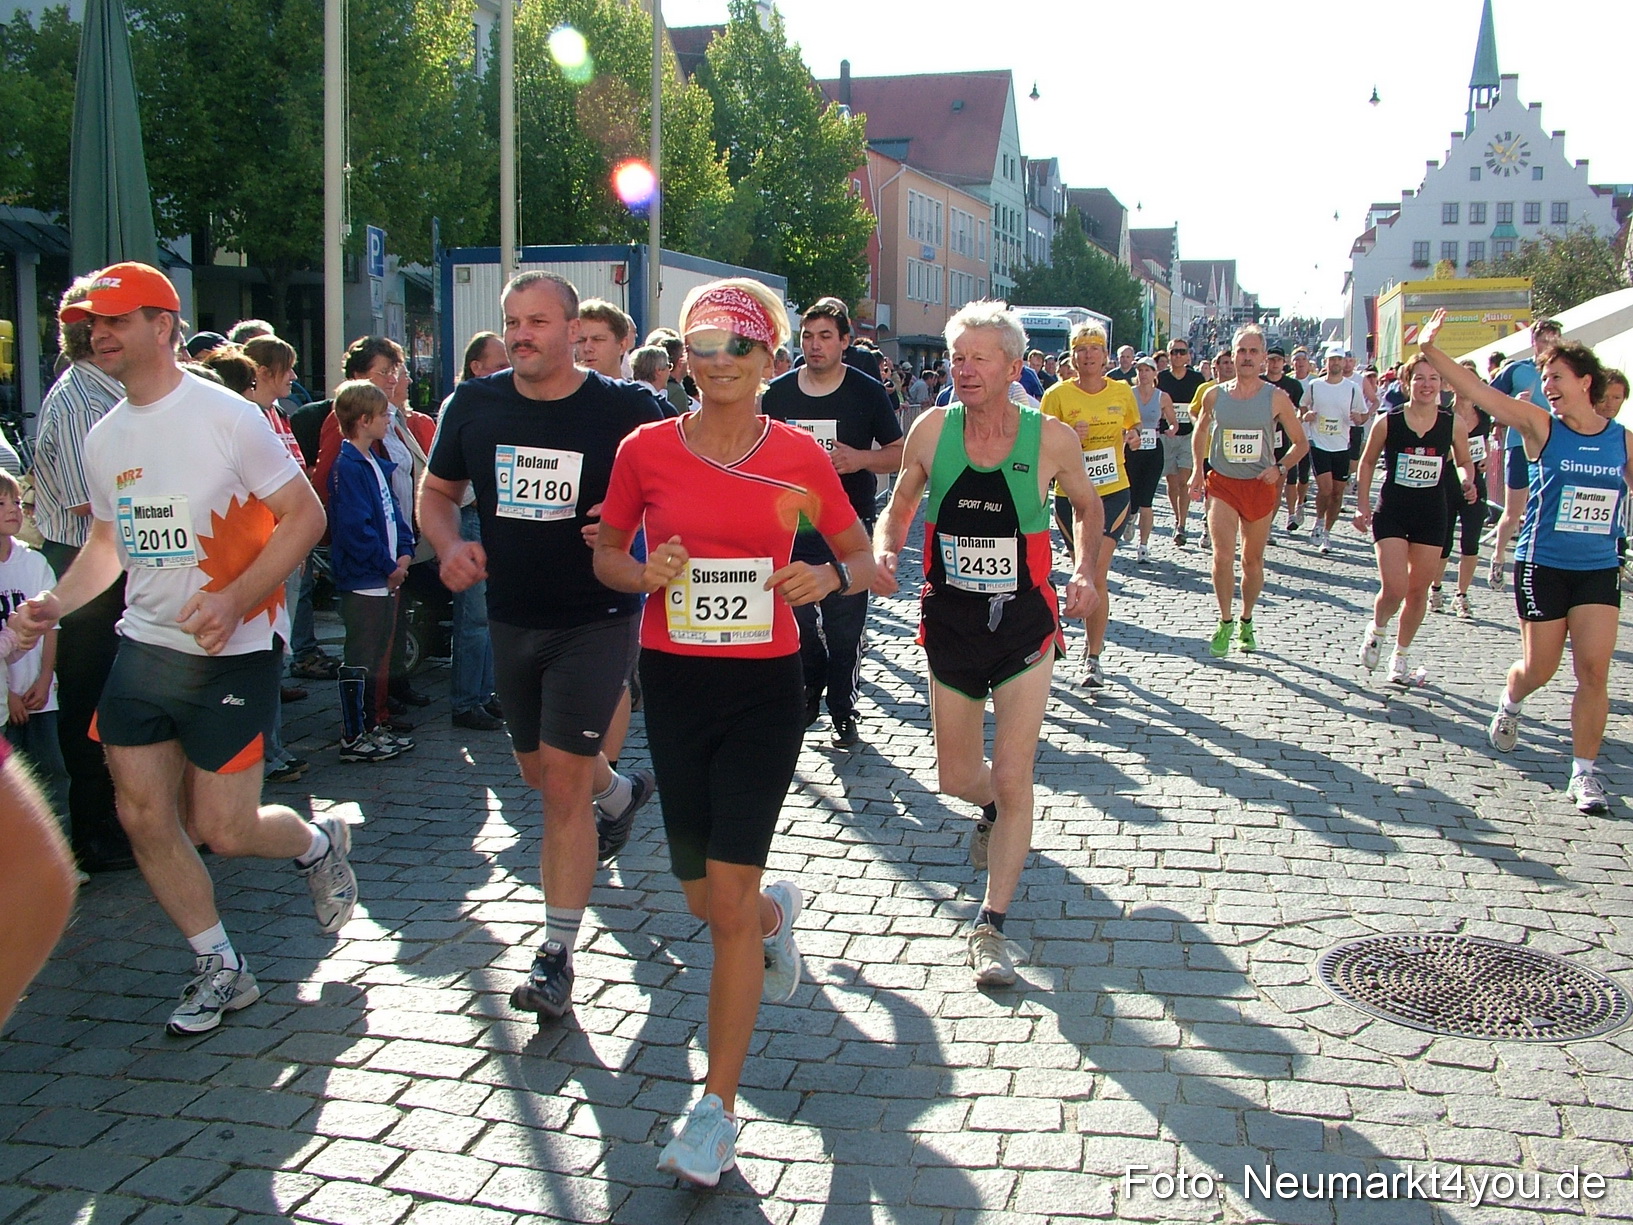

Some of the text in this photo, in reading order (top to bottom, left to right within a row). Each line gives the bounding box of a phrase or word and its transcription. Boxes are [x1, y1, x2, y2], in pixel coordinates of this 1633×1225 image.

[371, 233, 380, 269] P
[1233, 444, 1253, 454] 188
[516, 454, 559, 470] Roland
[1087, 462, 1115, 478] 2666
[1408, 458, 1438, 467] Christine
[1560, 459, 1622, 477] Sinupret
[1407, 468, 1437, 480] 2204
[500, 472, 572, 502] C 2180
[957, 499, 981, 510] SPORT
[1575, 491, 1606, 502] Martina
[134, 504, 174, 520] Michael
[1562, 502, 1611, 522] C 2135
[124, 526, 188, 551] D 2010
[957, 537, 996, 549] Johann
[945, 550, 1012, 576] C 2433
[692, 568, 757, 584] Susanne
[1521, 563, 1541, 617] inupret
[671, 591, 748, 621] C 532
